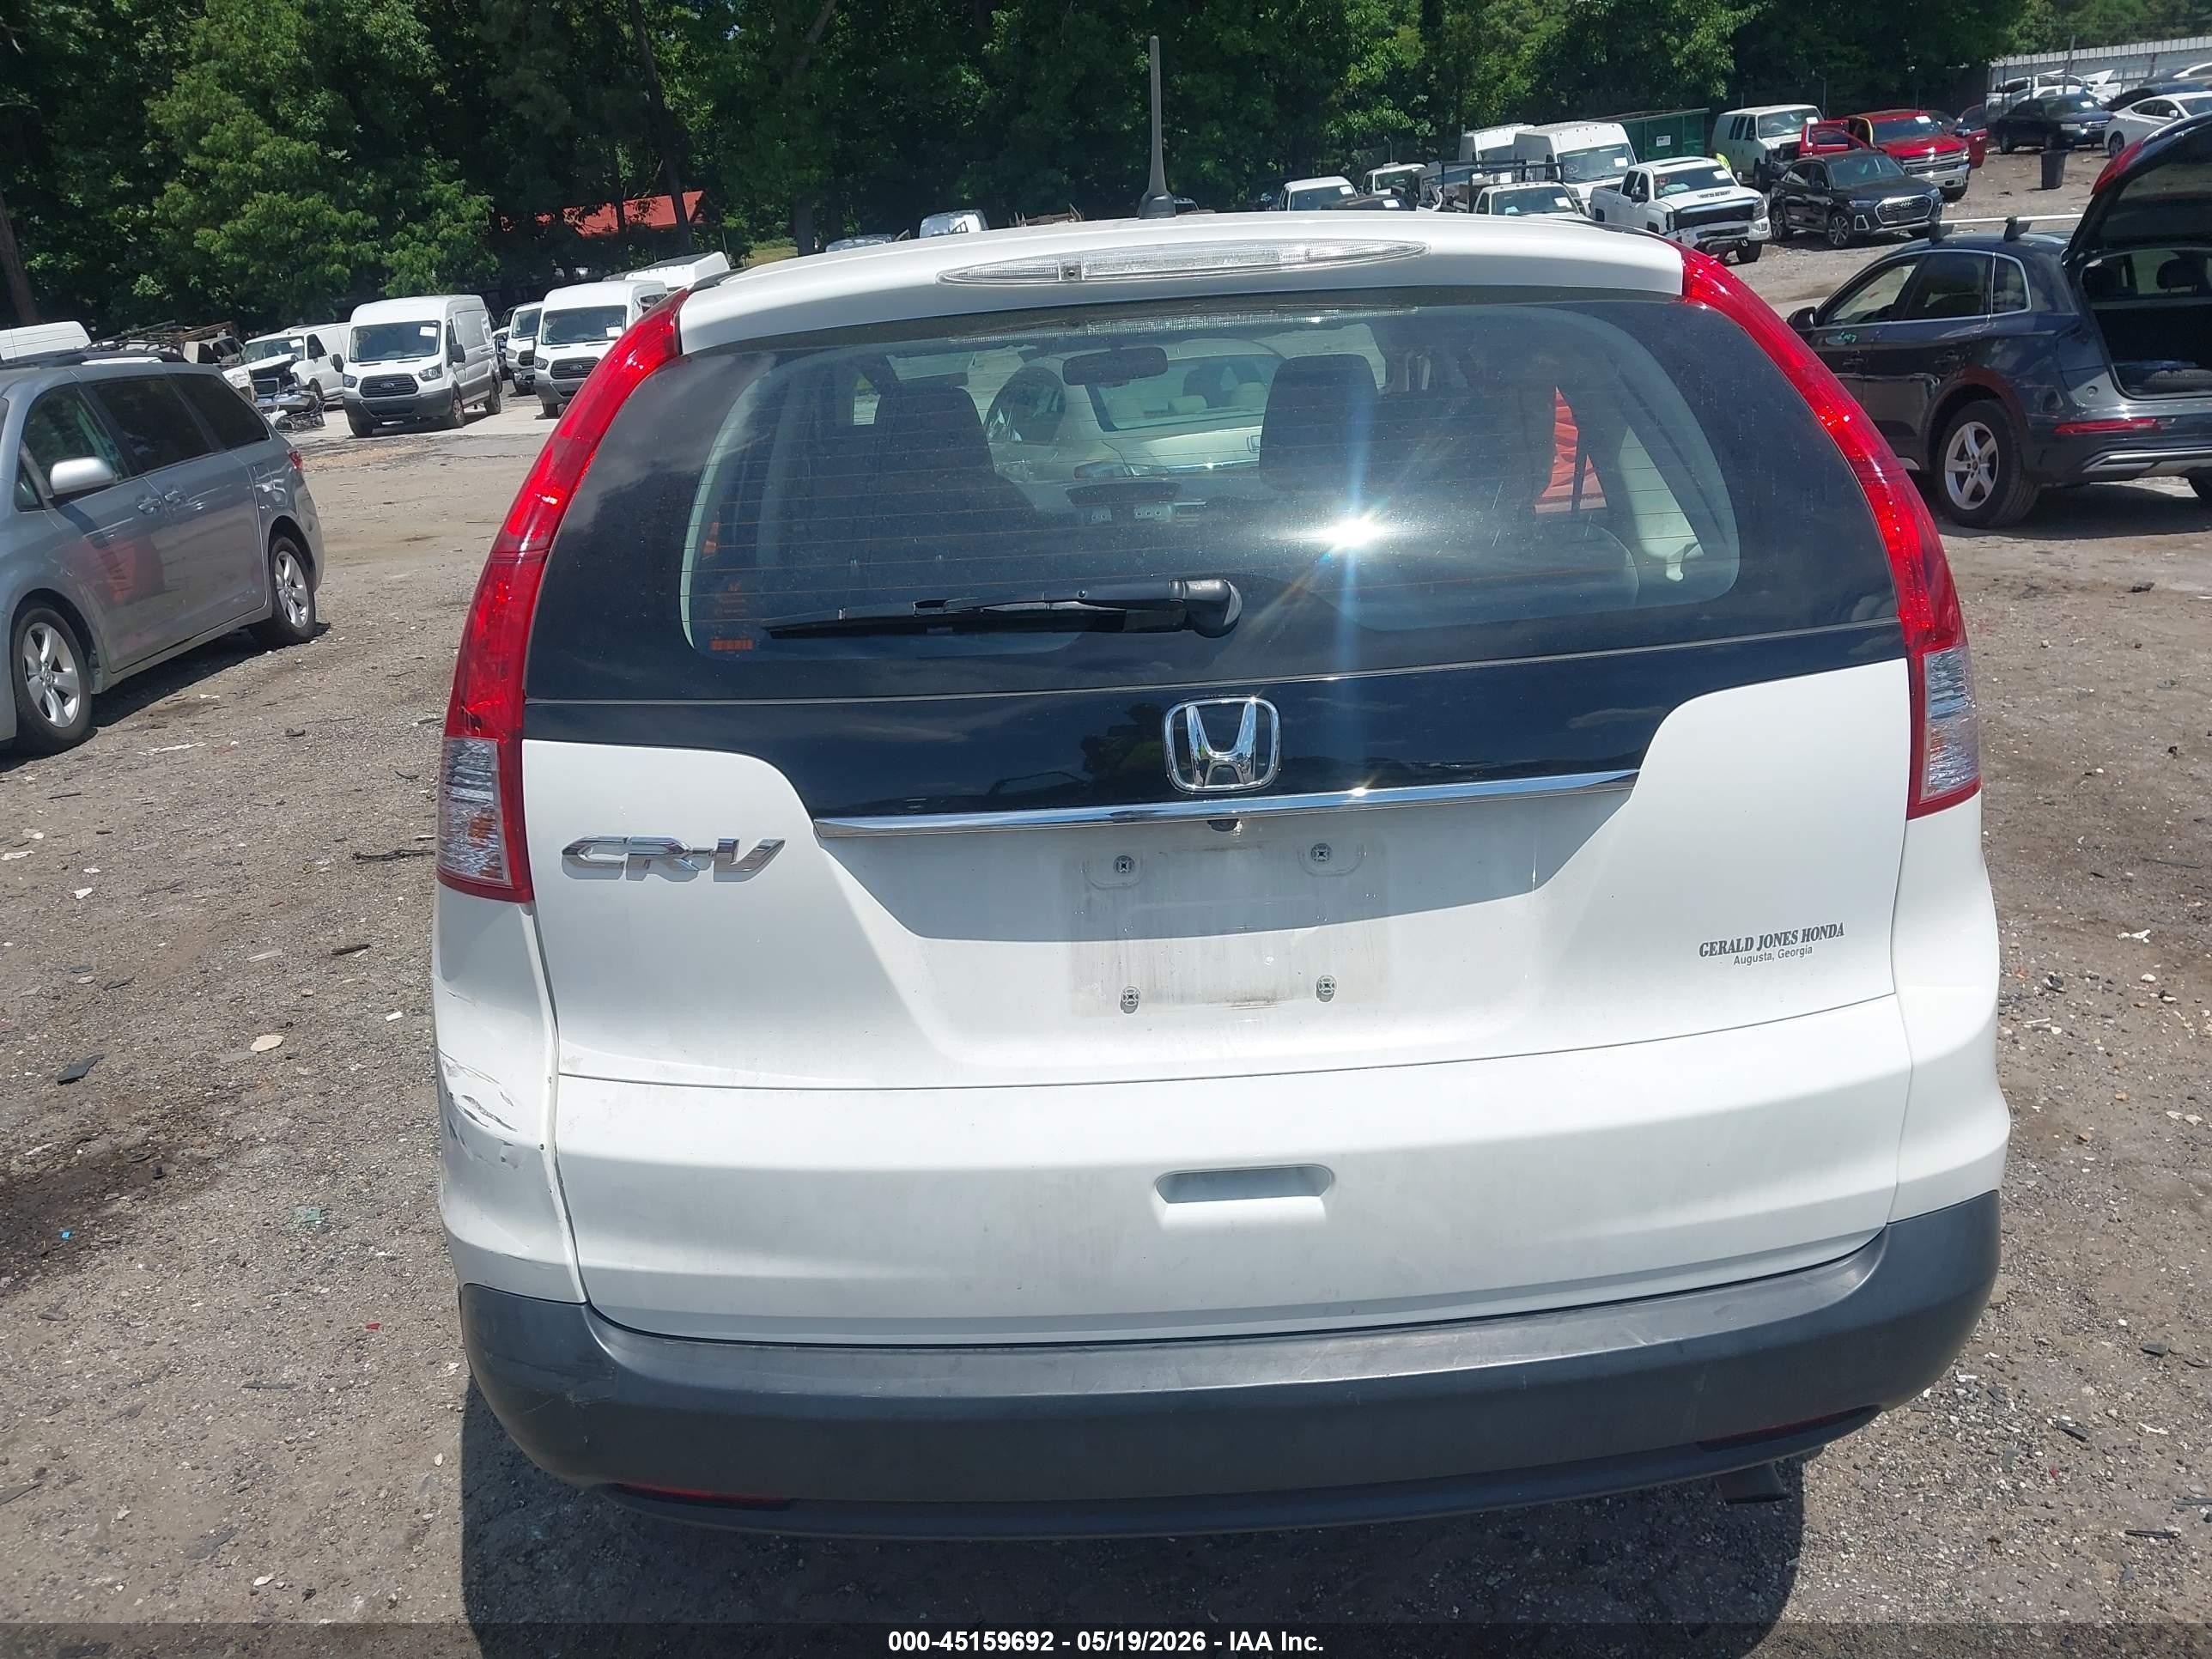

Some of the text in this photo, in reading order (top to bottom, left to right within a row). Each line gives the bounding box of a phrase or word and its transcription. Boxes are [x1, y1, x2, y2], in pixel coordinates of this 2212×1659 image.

[561, 836, 786, 874] CR-V
[1698, 921, 1845, 957] GERALD JONES HONDA
[1733, 945, 1813, 966] Augusta, Georgia
